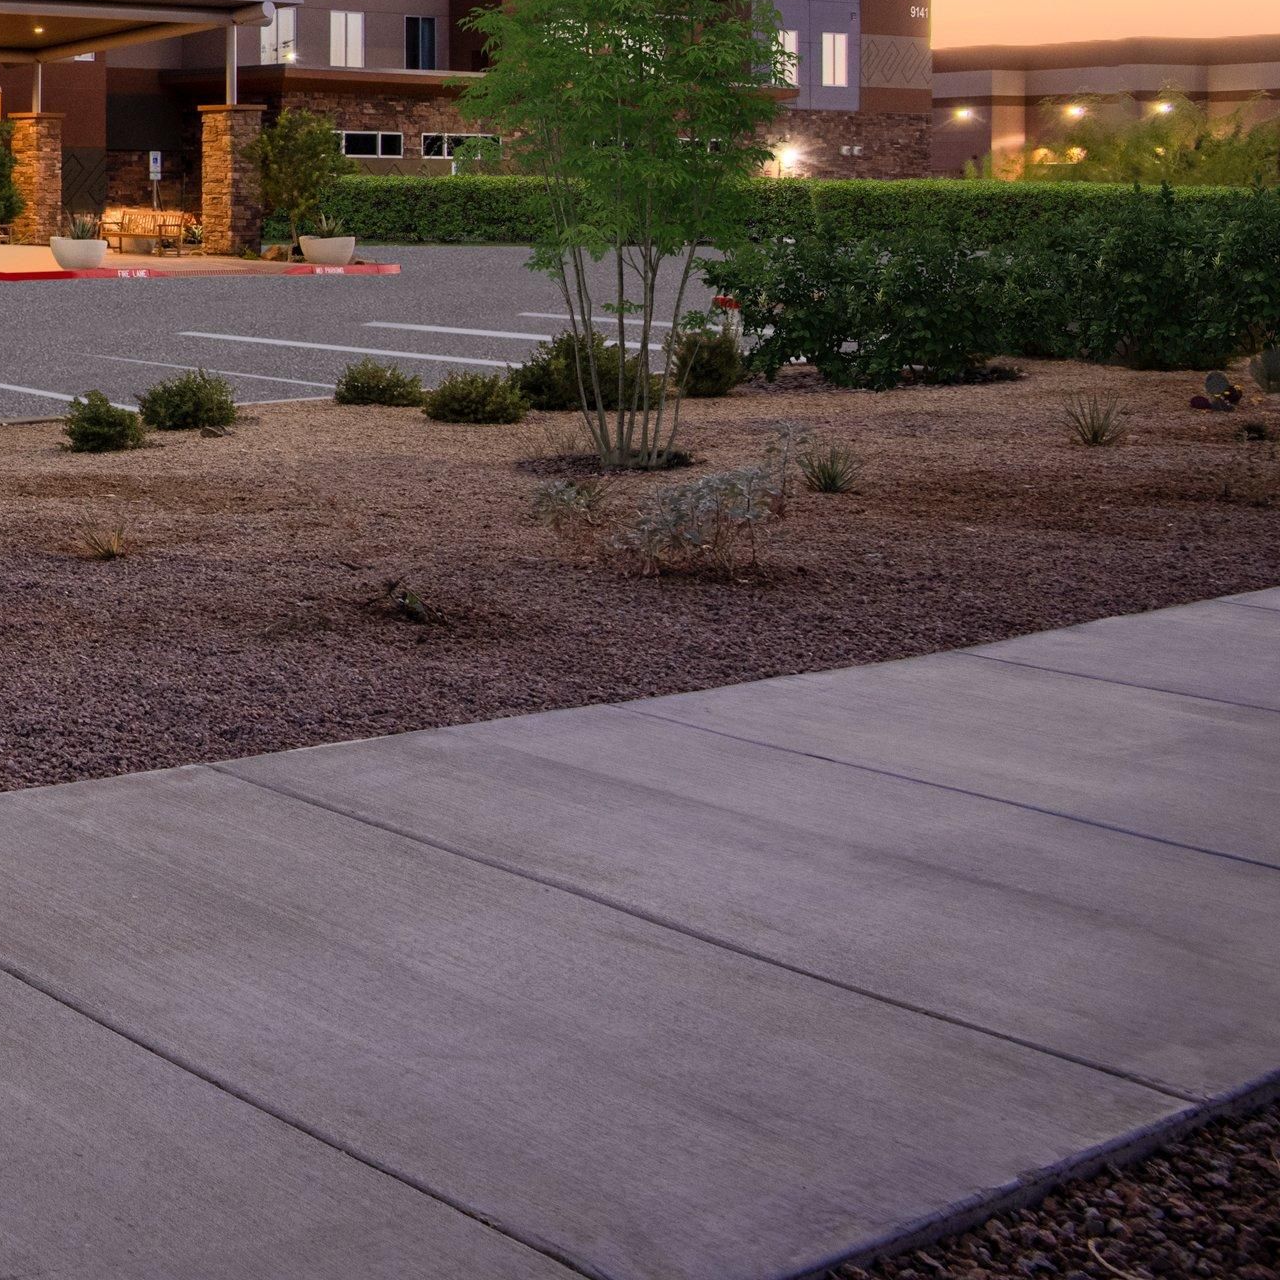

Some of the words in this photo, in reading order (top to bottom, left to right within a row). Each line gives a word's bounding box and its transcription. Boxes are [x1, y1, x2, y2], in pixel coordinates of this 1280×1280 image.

[910, 5, 929, 19] 9141
[117, 269, 130, 278] FIRE
[132, 269, 147, 278] LANE
